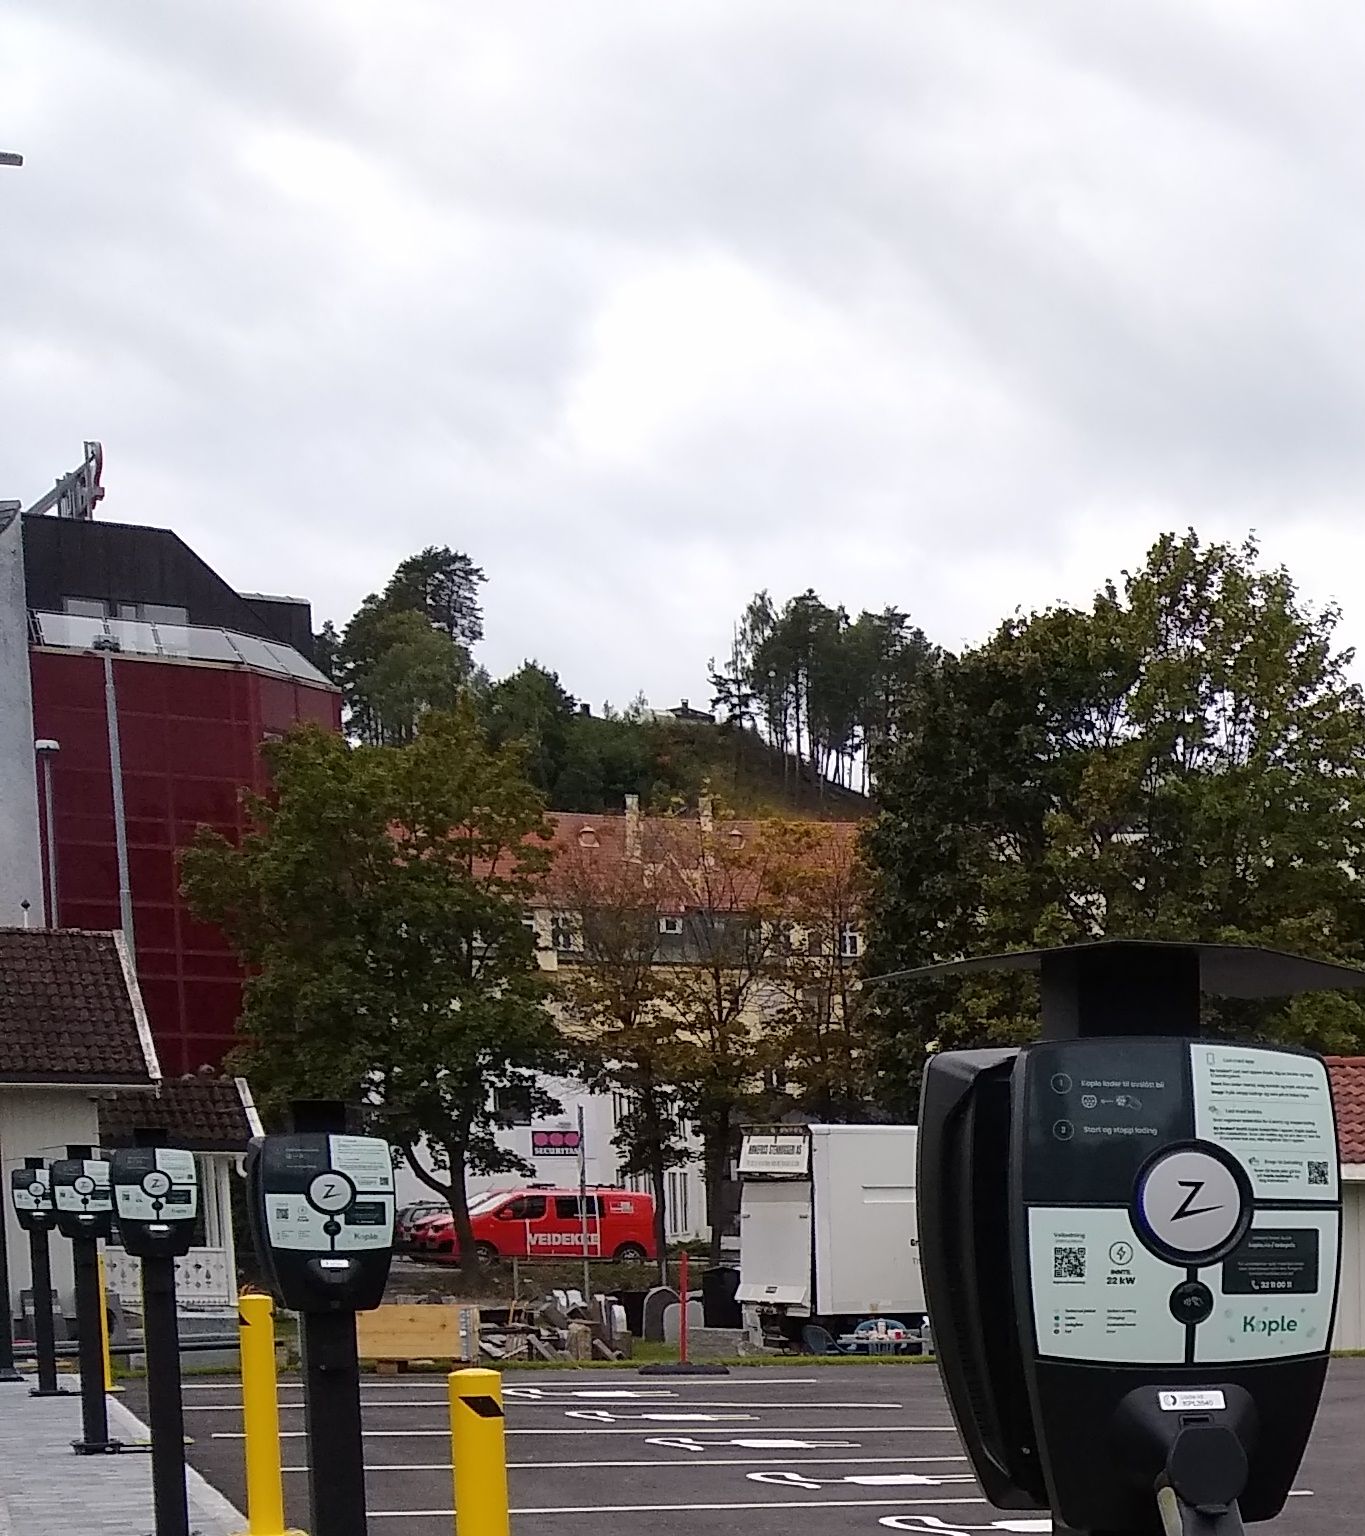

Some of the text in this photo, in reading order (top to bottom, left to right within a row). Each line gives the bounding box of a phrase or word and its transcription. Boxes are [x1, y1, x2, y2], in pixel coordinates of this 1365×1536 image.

[1106, 1276, 1136, 1285] 22 kW
[1242, 1314, 1298, 1337] Kople
